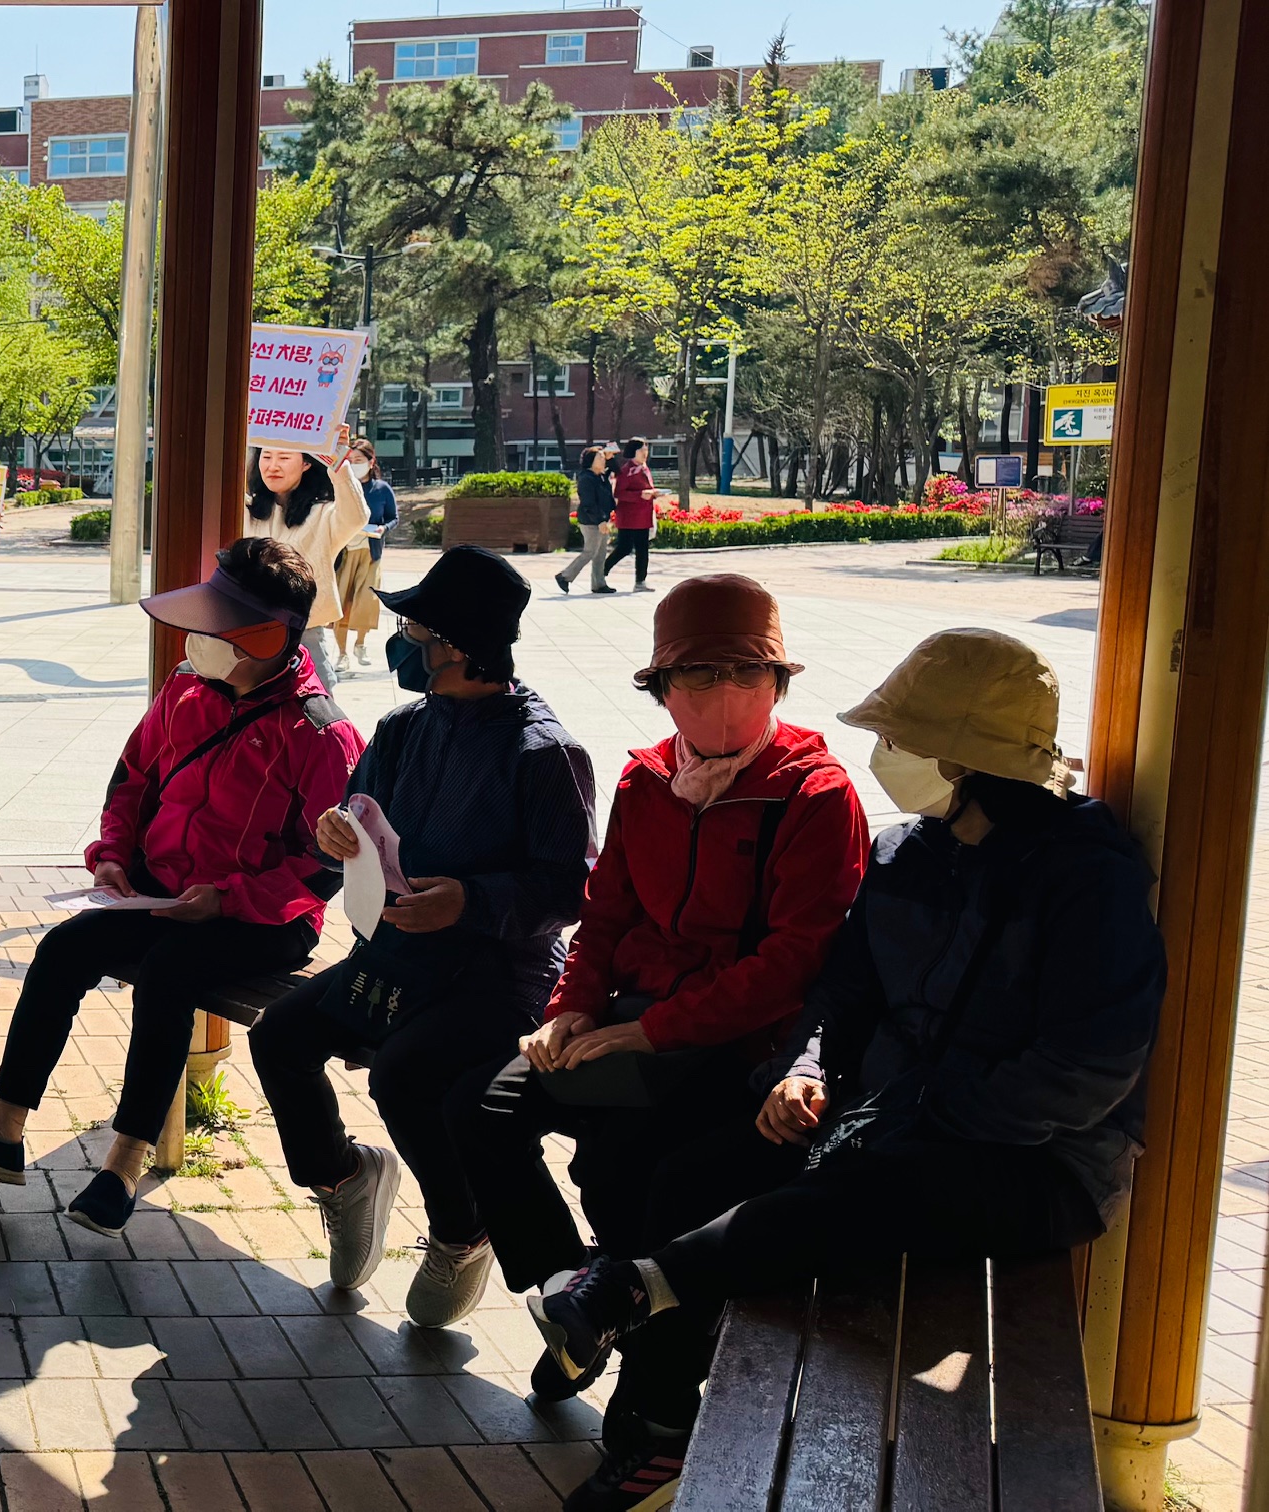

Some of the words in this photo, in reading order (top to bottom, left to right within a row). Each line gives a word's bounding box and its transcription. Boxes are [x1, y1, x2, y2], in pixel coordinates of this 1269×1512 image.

[276, 344, 313, 365] 차량,
[250, 374, 266, 393] 한
[268, 377, 307, 397] 시선!
